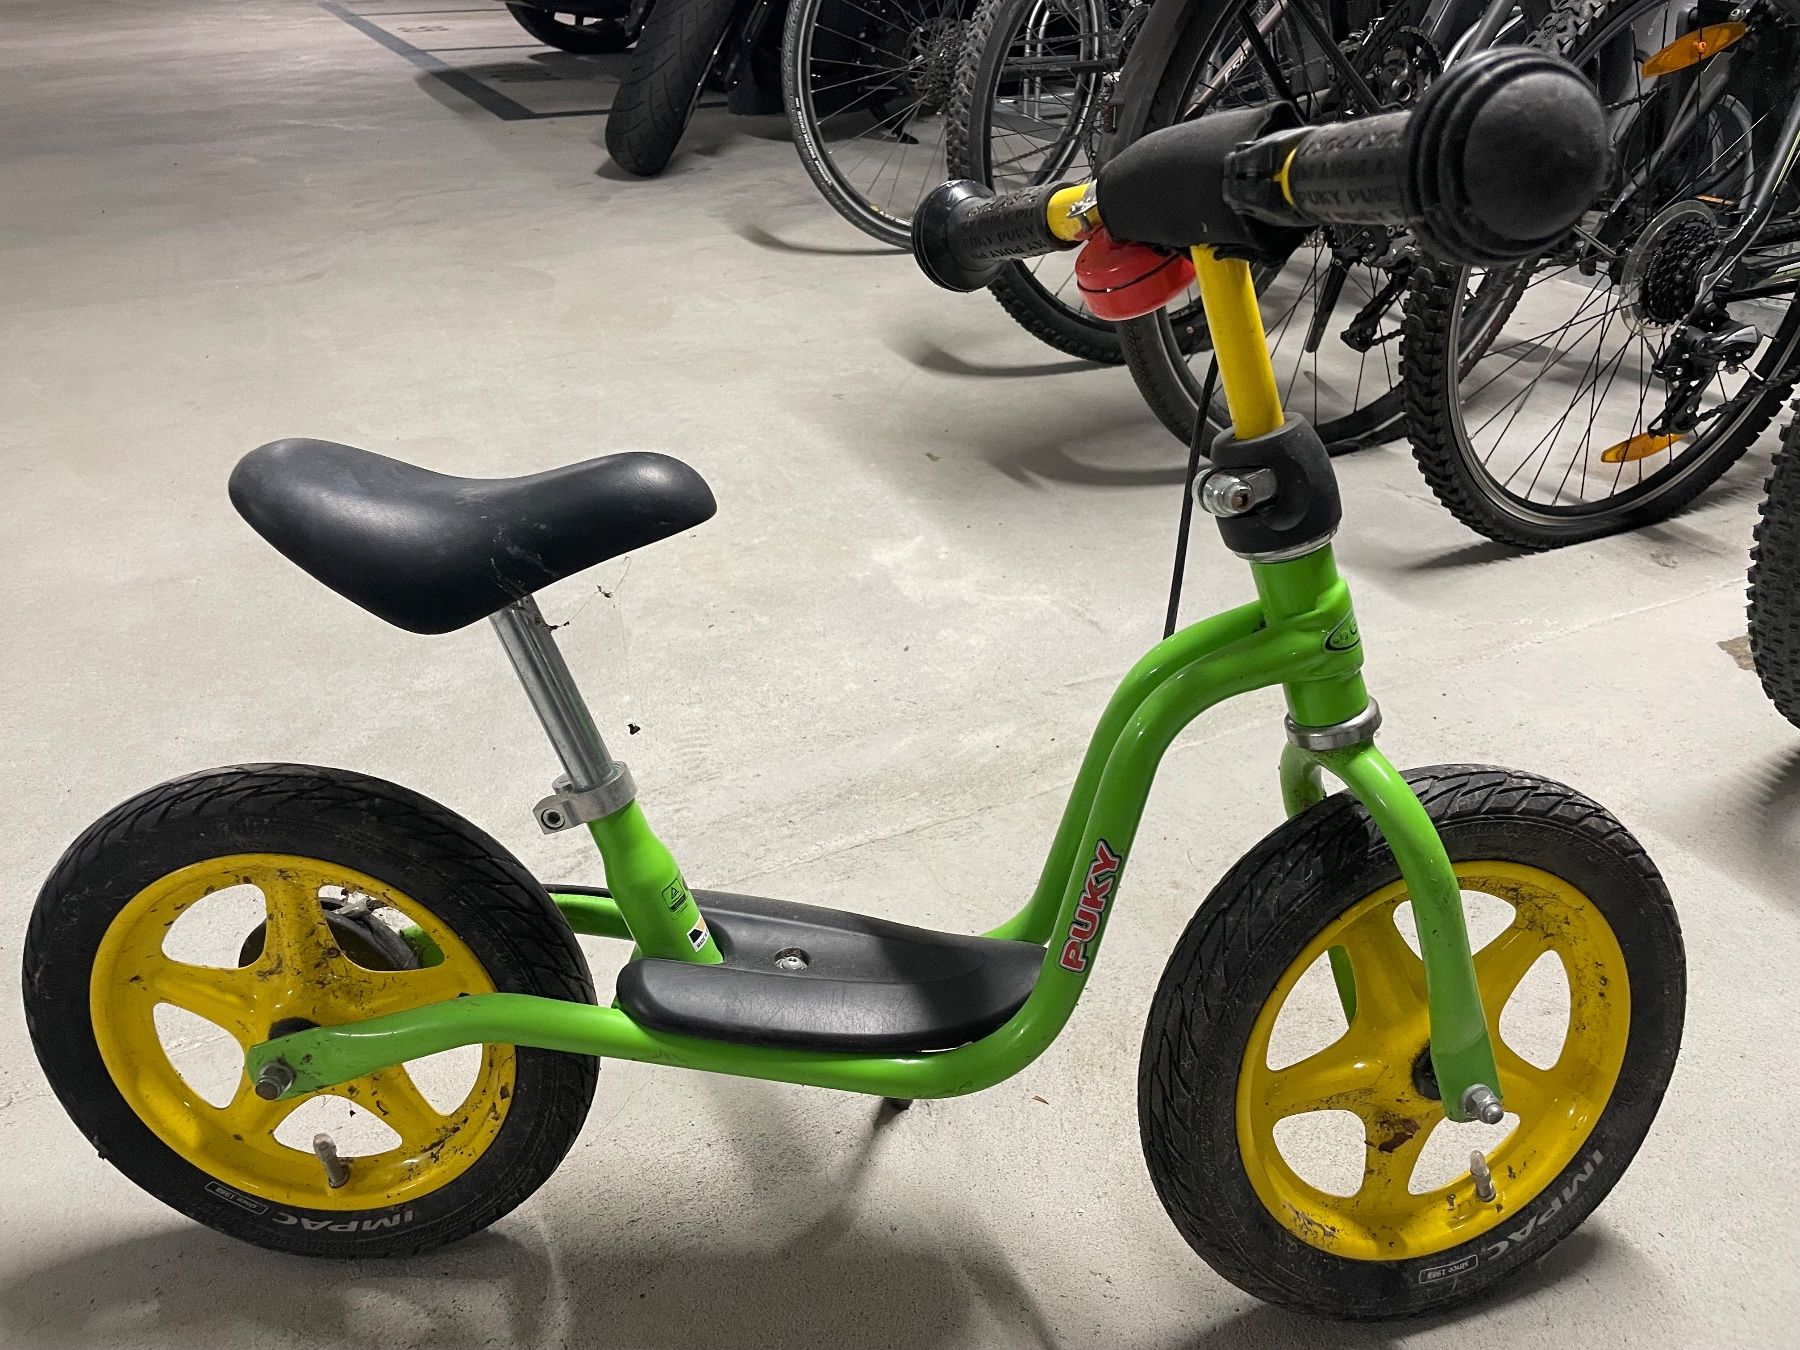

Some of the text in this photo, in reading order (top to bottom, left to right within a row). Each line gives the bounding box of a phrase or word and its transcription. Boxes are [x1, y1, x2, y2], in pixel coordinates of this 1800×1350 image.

[1060, 839, 1121, 971] PUKY
[272, 1210, 414, 1232] IMPAC
[1486, 1150, 1604, 1261] IMPAC
